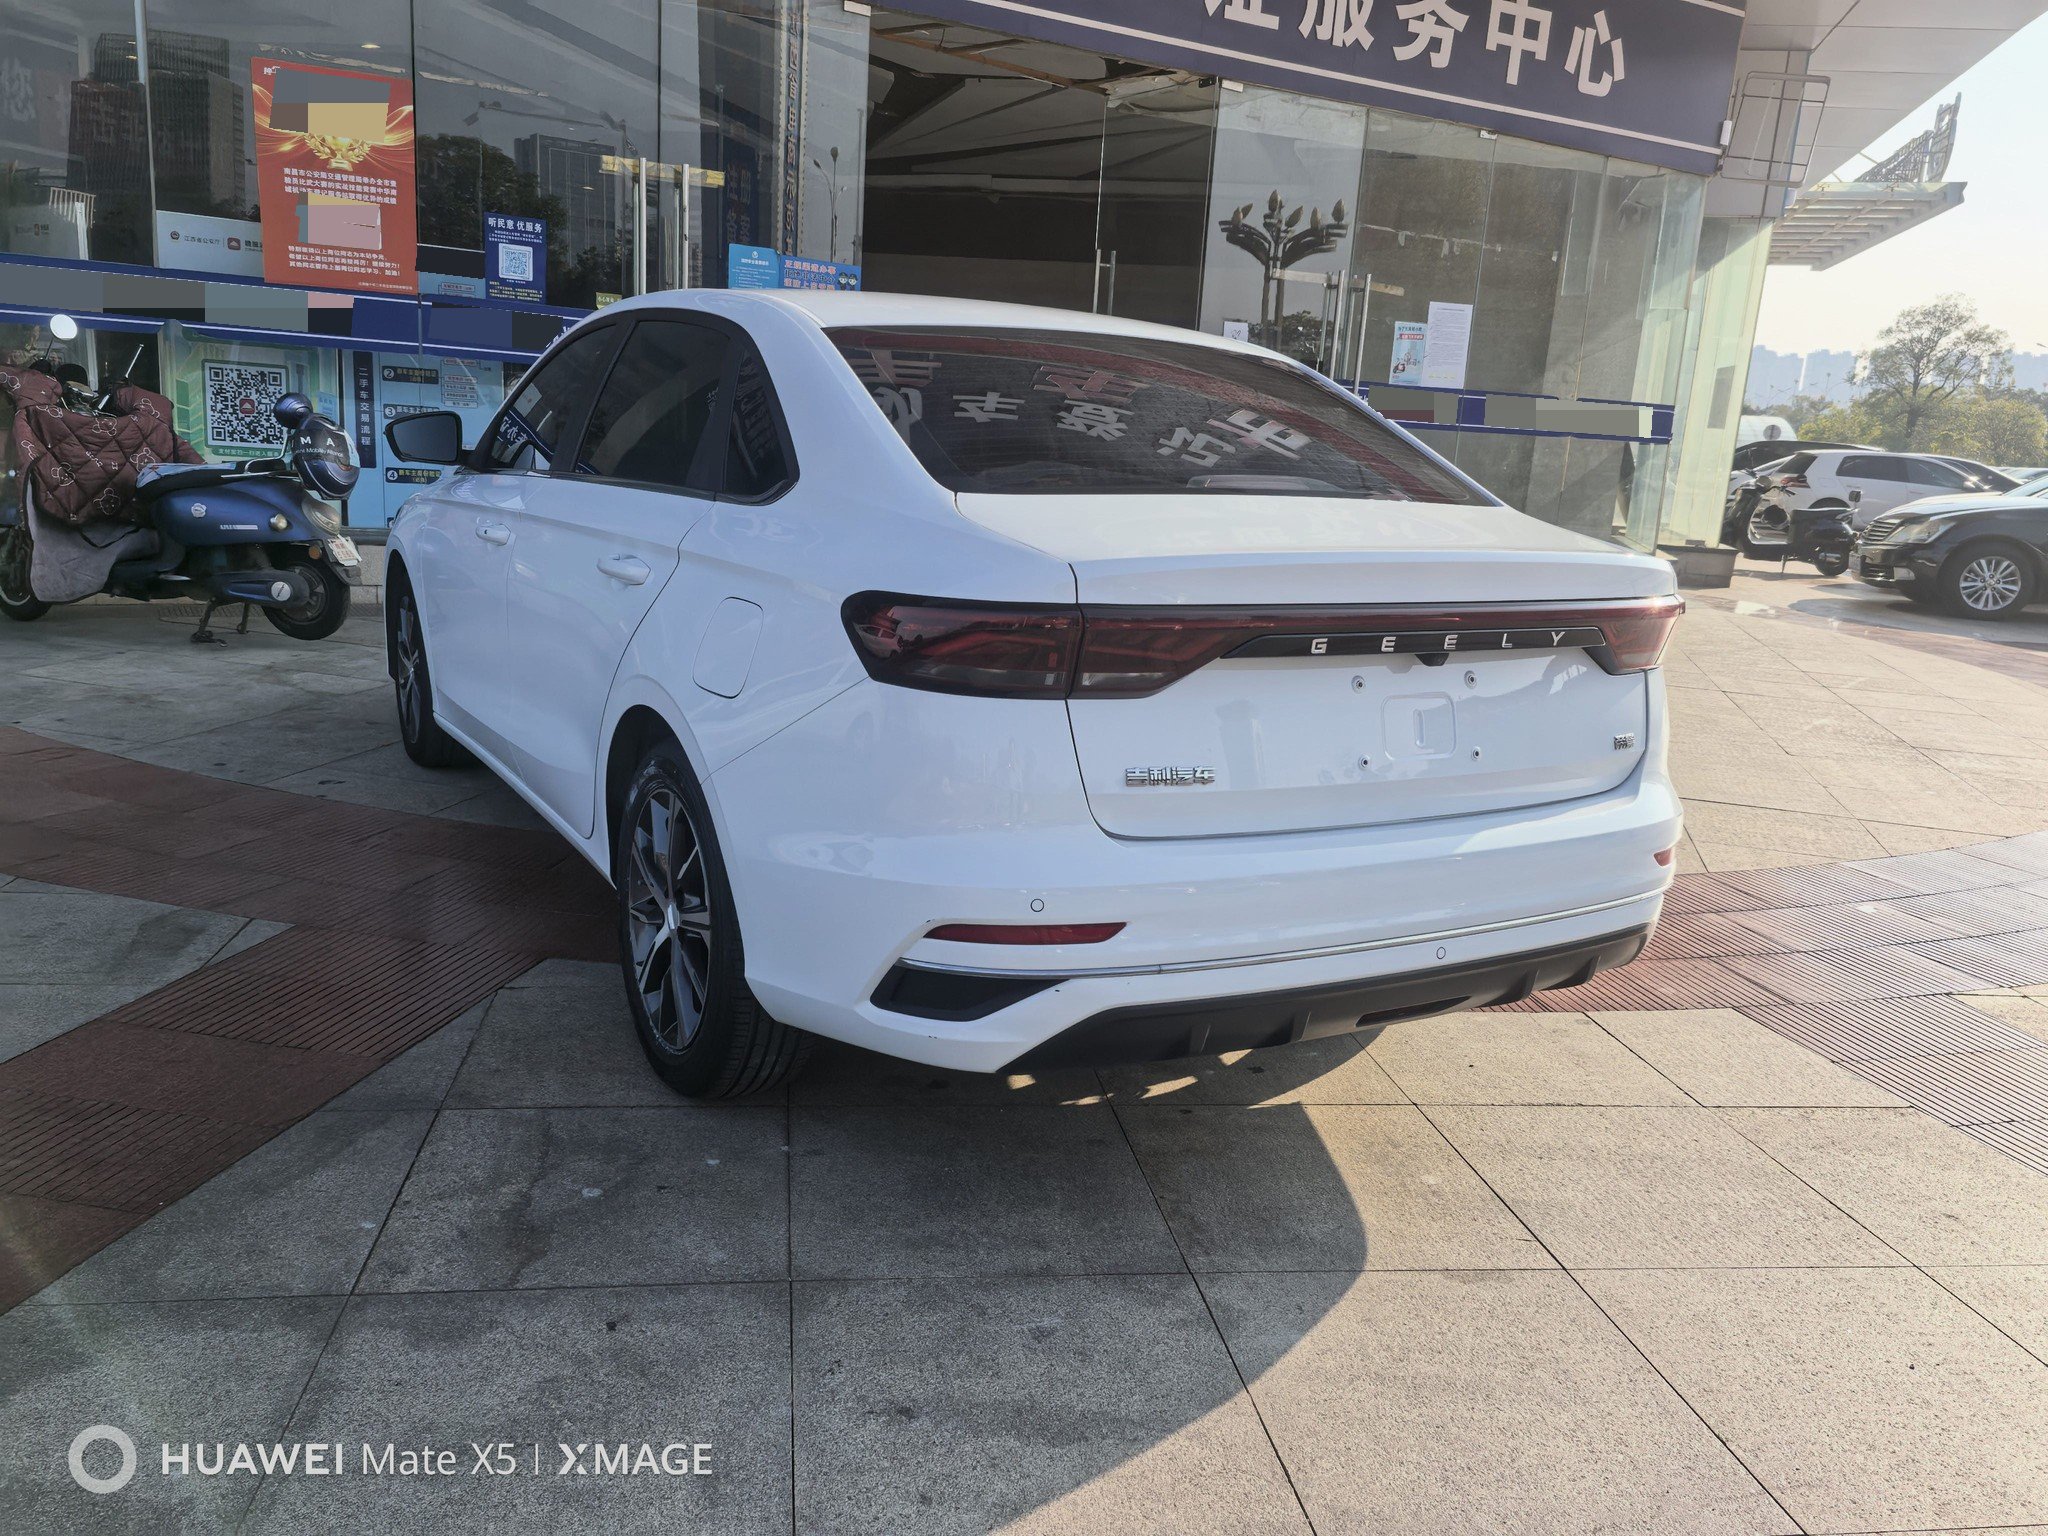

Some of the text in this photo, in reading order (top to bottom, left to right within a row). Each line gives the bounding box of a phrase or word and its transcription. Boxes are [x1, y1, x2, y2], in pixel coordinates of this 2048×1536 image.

[488, 217, 543, 234] 听民意 优服务
[358, 367, 372, 447] 二手车交易流程
[1310, 631, 1568, 655] GEELY
[1126, 767, 1216, 787] 吉利汽车
